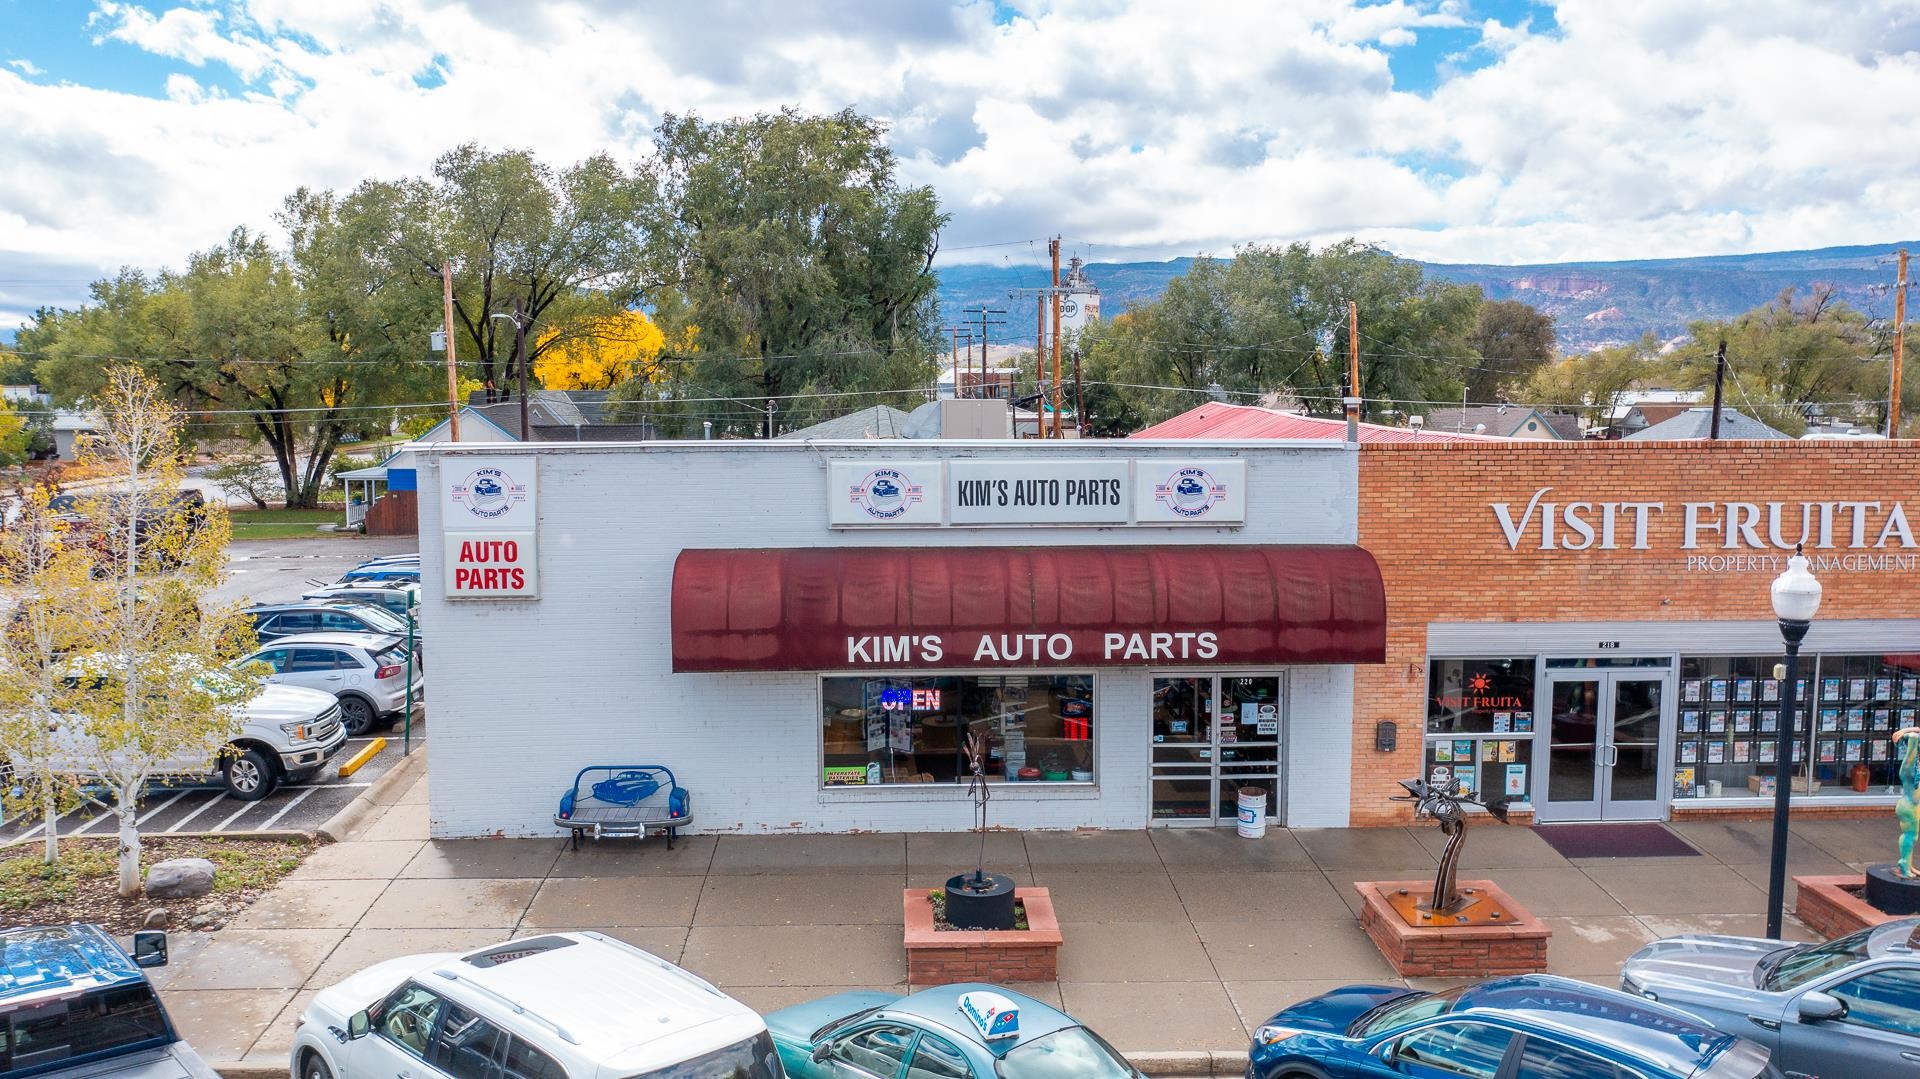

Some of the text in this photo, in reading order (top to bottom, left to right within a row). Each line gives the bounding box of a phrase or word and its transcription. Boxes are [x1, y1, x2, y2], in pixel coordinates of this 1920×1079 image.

[476, 469, 502, 477] KIM'S
[874, 470, 900, 478] KIM'S
[1180, 469, 1204, 477] KIM'S
[957, 478, 1121, 507] KIM'S AUTO PARTS
[470, 505, 509, 518] AUTO PARTS
[867, 506, 905, 518] AUTO PARTS
[1173, 504, 1210, 517] AUTO PARTS
[1489, 487, 1919, 551] VISIT FRUITA
[459, 540, 518, 563] AUTO
[1687, 554, 1919, 572] PROPERTY ANAGEMENT
[455, 567, 525, 590] PARTS
[846, 631, 1219, 663] KIM'S AUTO PARTS
[1239, 678, 1253, 686] 220
[881, 688, 941, 711] OPEN
[1436, 696, 1522, 708] VISIT FRUITA
[963, 995, 988, 1032] Domino's
